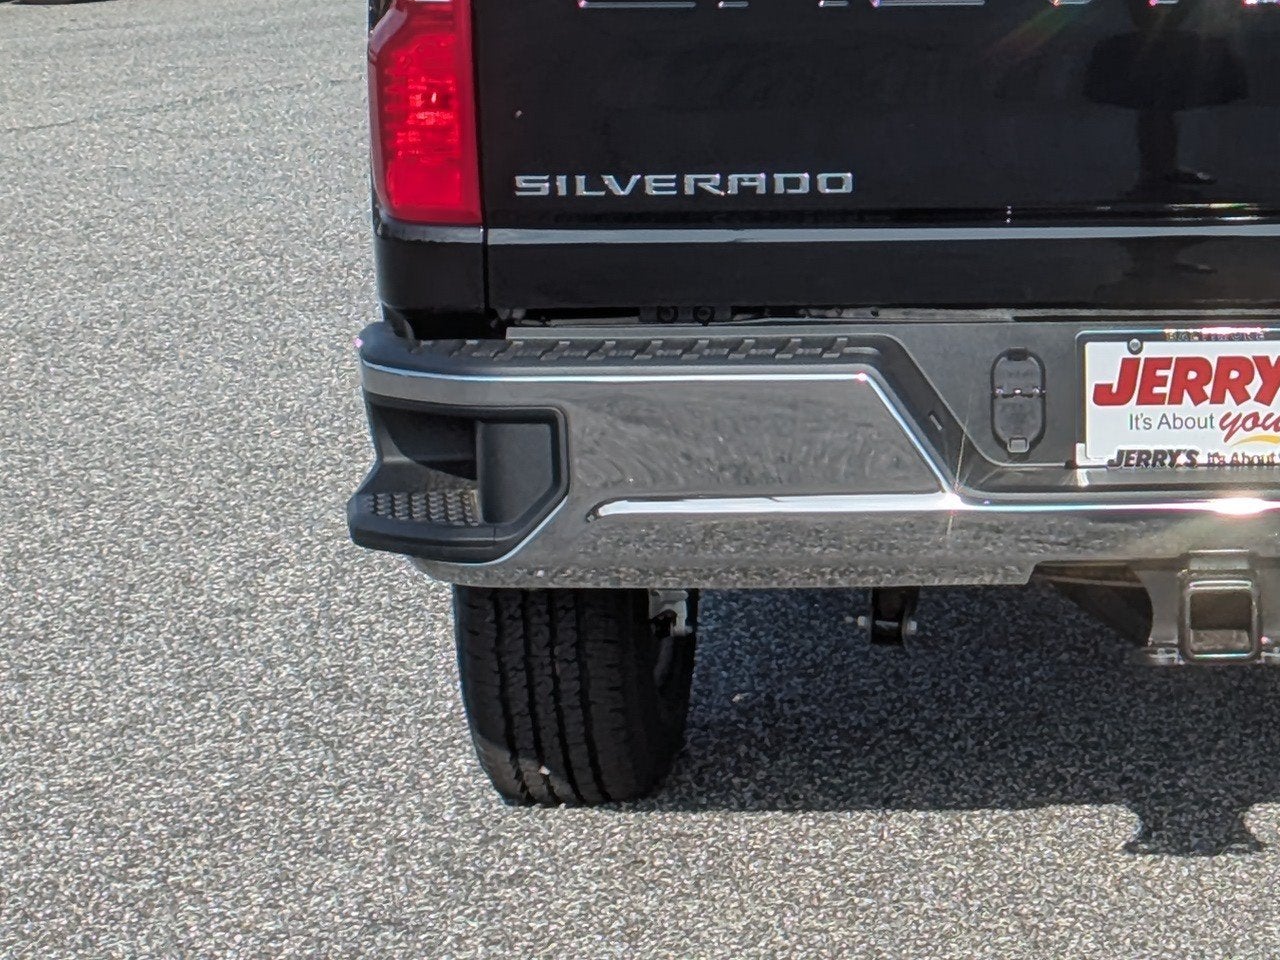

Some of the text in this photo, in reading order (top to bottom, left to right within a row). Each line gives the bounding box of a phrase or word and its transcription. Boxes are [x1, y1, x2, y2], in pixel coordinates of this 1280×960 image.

[514, 172, 853, 196] SILVERADO
[1129, 413, 1152, 430] It's
[1157, 413, 1214, 430] About
[1107, 449, 1199, 468] JERRY'S
[1230, 451, 1276, 467] About
